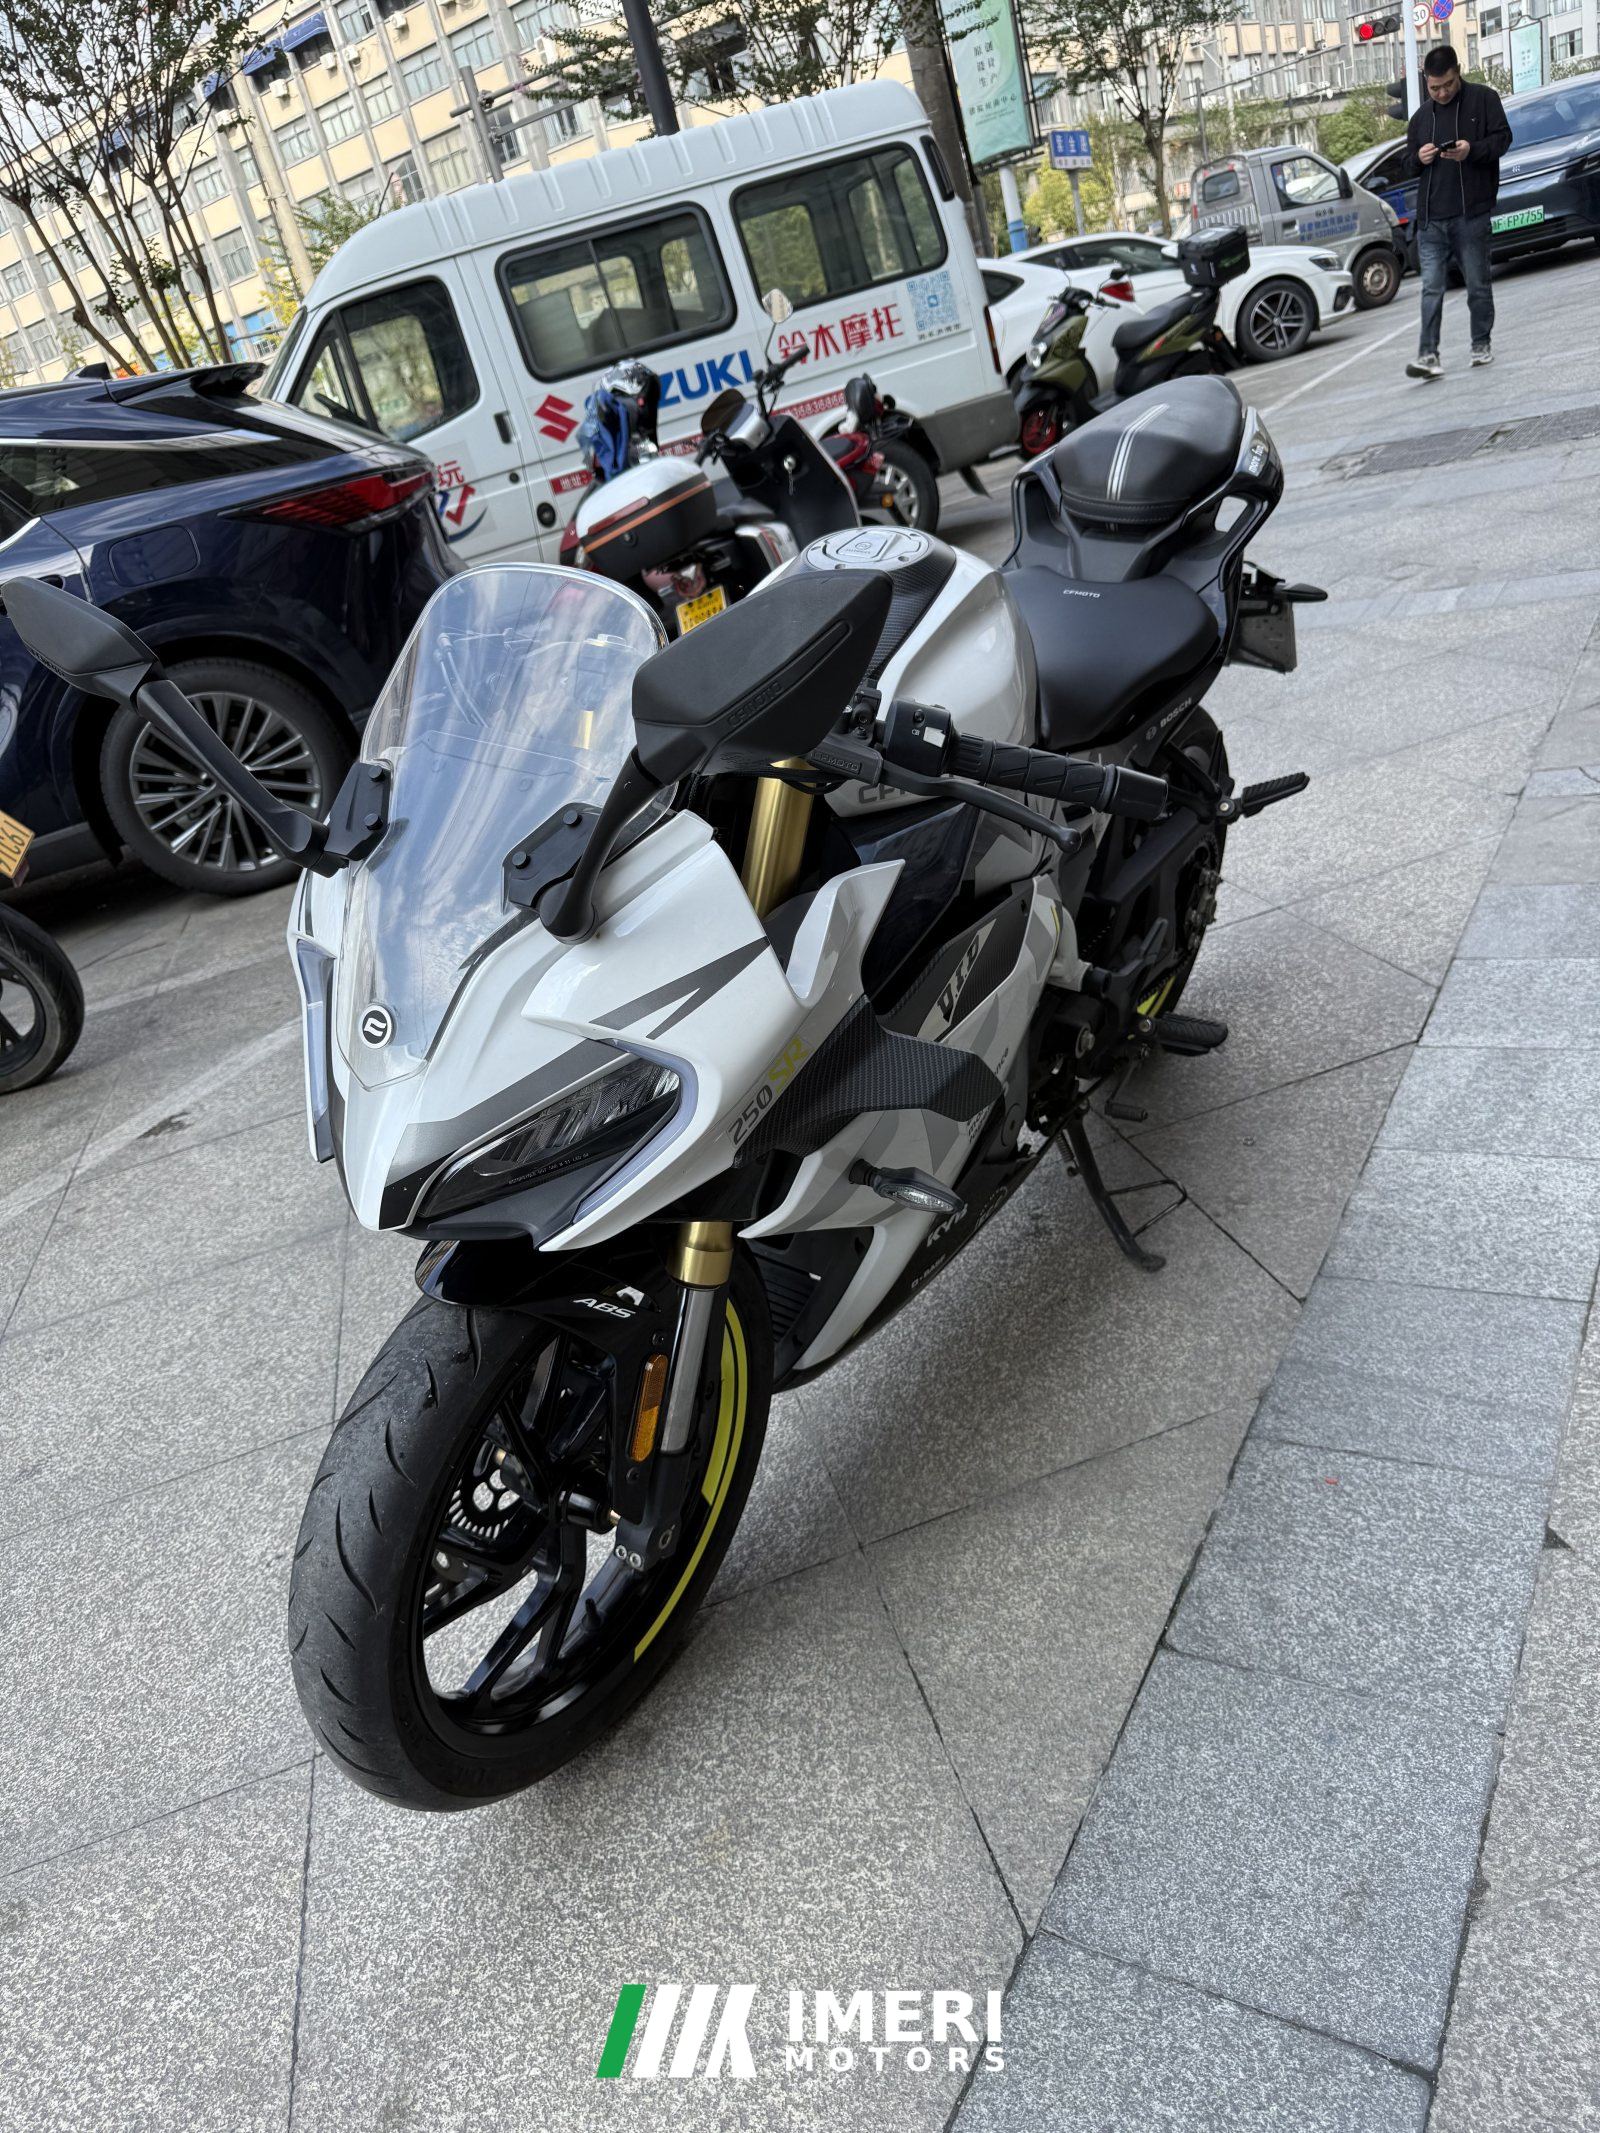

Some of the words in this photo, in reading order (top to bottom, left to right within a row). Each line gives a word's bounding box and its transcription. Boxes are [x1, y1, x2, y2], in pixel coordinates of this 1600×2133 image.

[656, 350, 754, 410] ZUKI
[1063, 589, 1101, 599] CFMOTO
[1160, 697, 1192, 728] BOSCH
[573, 1298, 637, 1318] ABS
